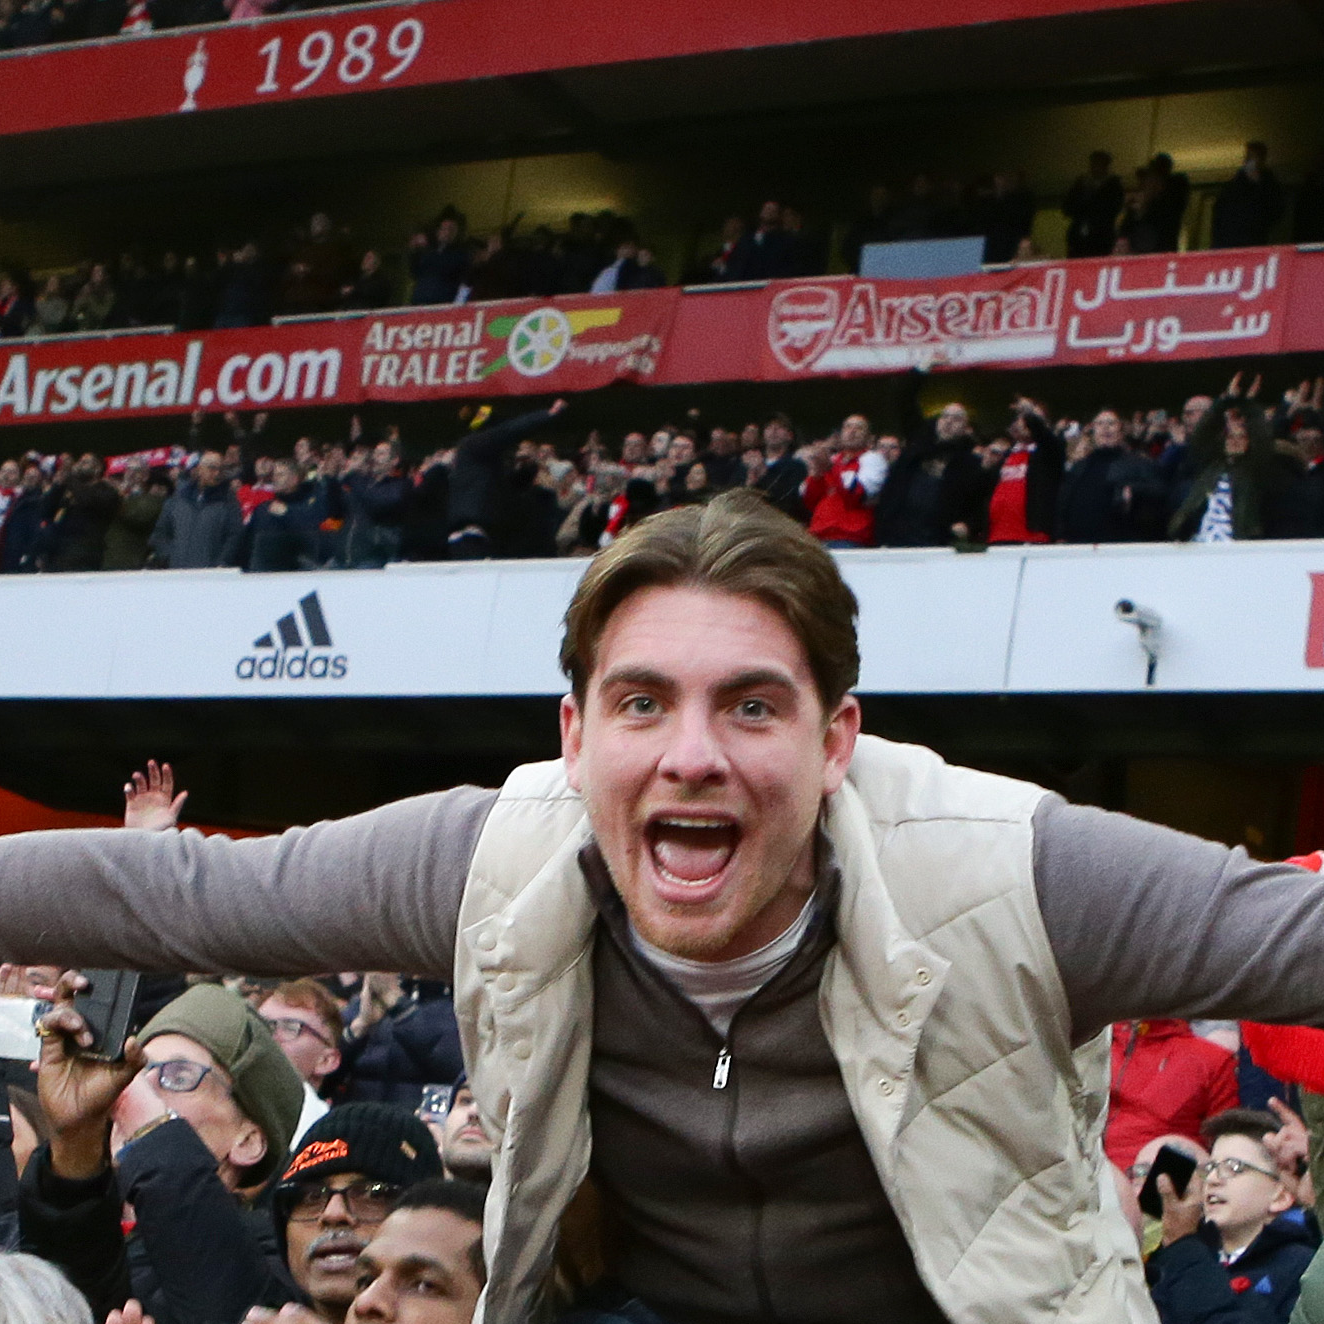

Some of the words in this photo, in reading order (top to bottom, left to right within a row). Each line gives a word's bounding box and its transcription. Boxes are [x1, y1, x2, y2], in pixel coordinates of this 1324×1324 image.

[257, 19, 424, 94] 1989
[831, 267, 1067, 346] Arsenal
[362, 309, 485, 350] Arsenal
[361, 348, 488, 388] TRALEE
[236, 643, 348, 681] adidas
